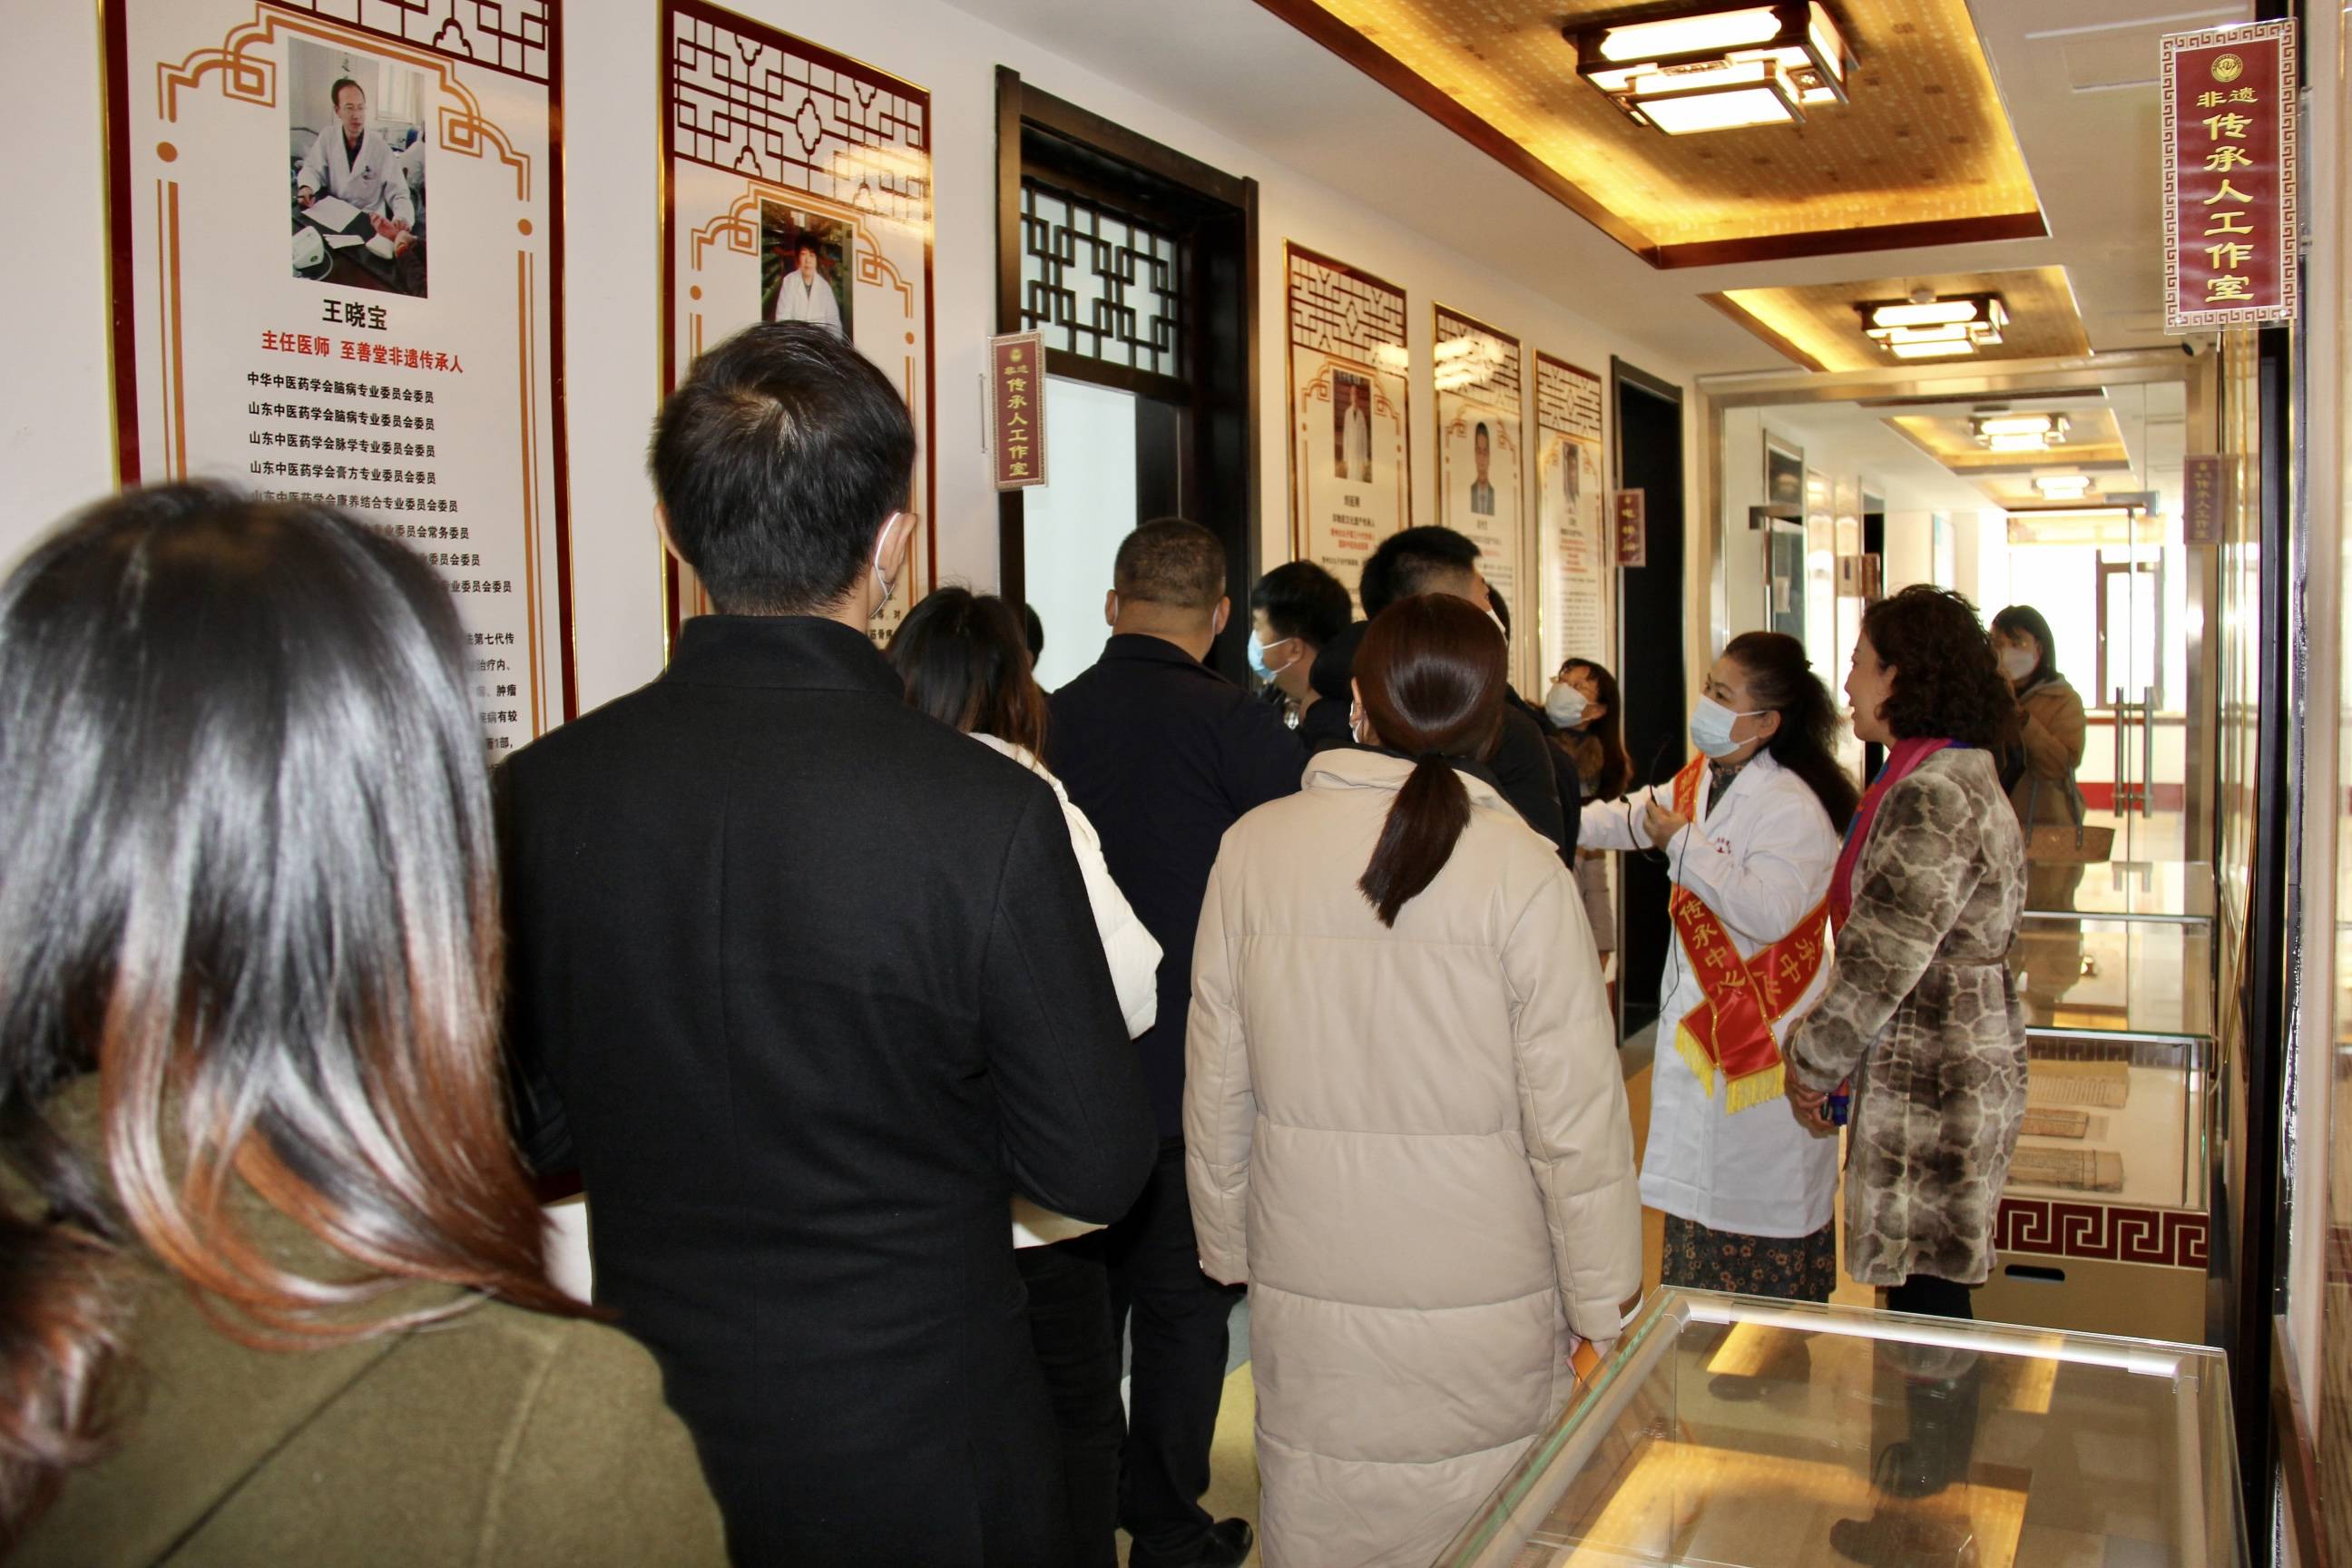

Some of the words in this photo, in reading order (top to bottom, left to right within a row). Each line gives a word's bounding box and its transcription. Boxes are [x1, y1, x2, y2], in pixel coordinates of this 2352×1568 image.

[2197, 87, 2258, 108] 非遗
[2202, 113, 2254, 303] 传承人工作室
[321, 299, 387, 331] 王晓宝
[261, 330, 330, 358] 主任医师
[340, 340, 464, 374] 至善堂非遗传承人
[247, 371, 435, 404] 中华中医药学会脑病专业委员会委员
[248, 401, 436, 431] 山东中医药学会脑病专业委员会委员
[1006, 377, 1029, 477] 传承人工作室
[249, 430, 436, 458] 山东中医药学会脉学专业委员会委员
[250, 460, 436, 485] 山东中医药学会膏方专业委员会委员
[1679, 899, 1747, 995] 传承中心
